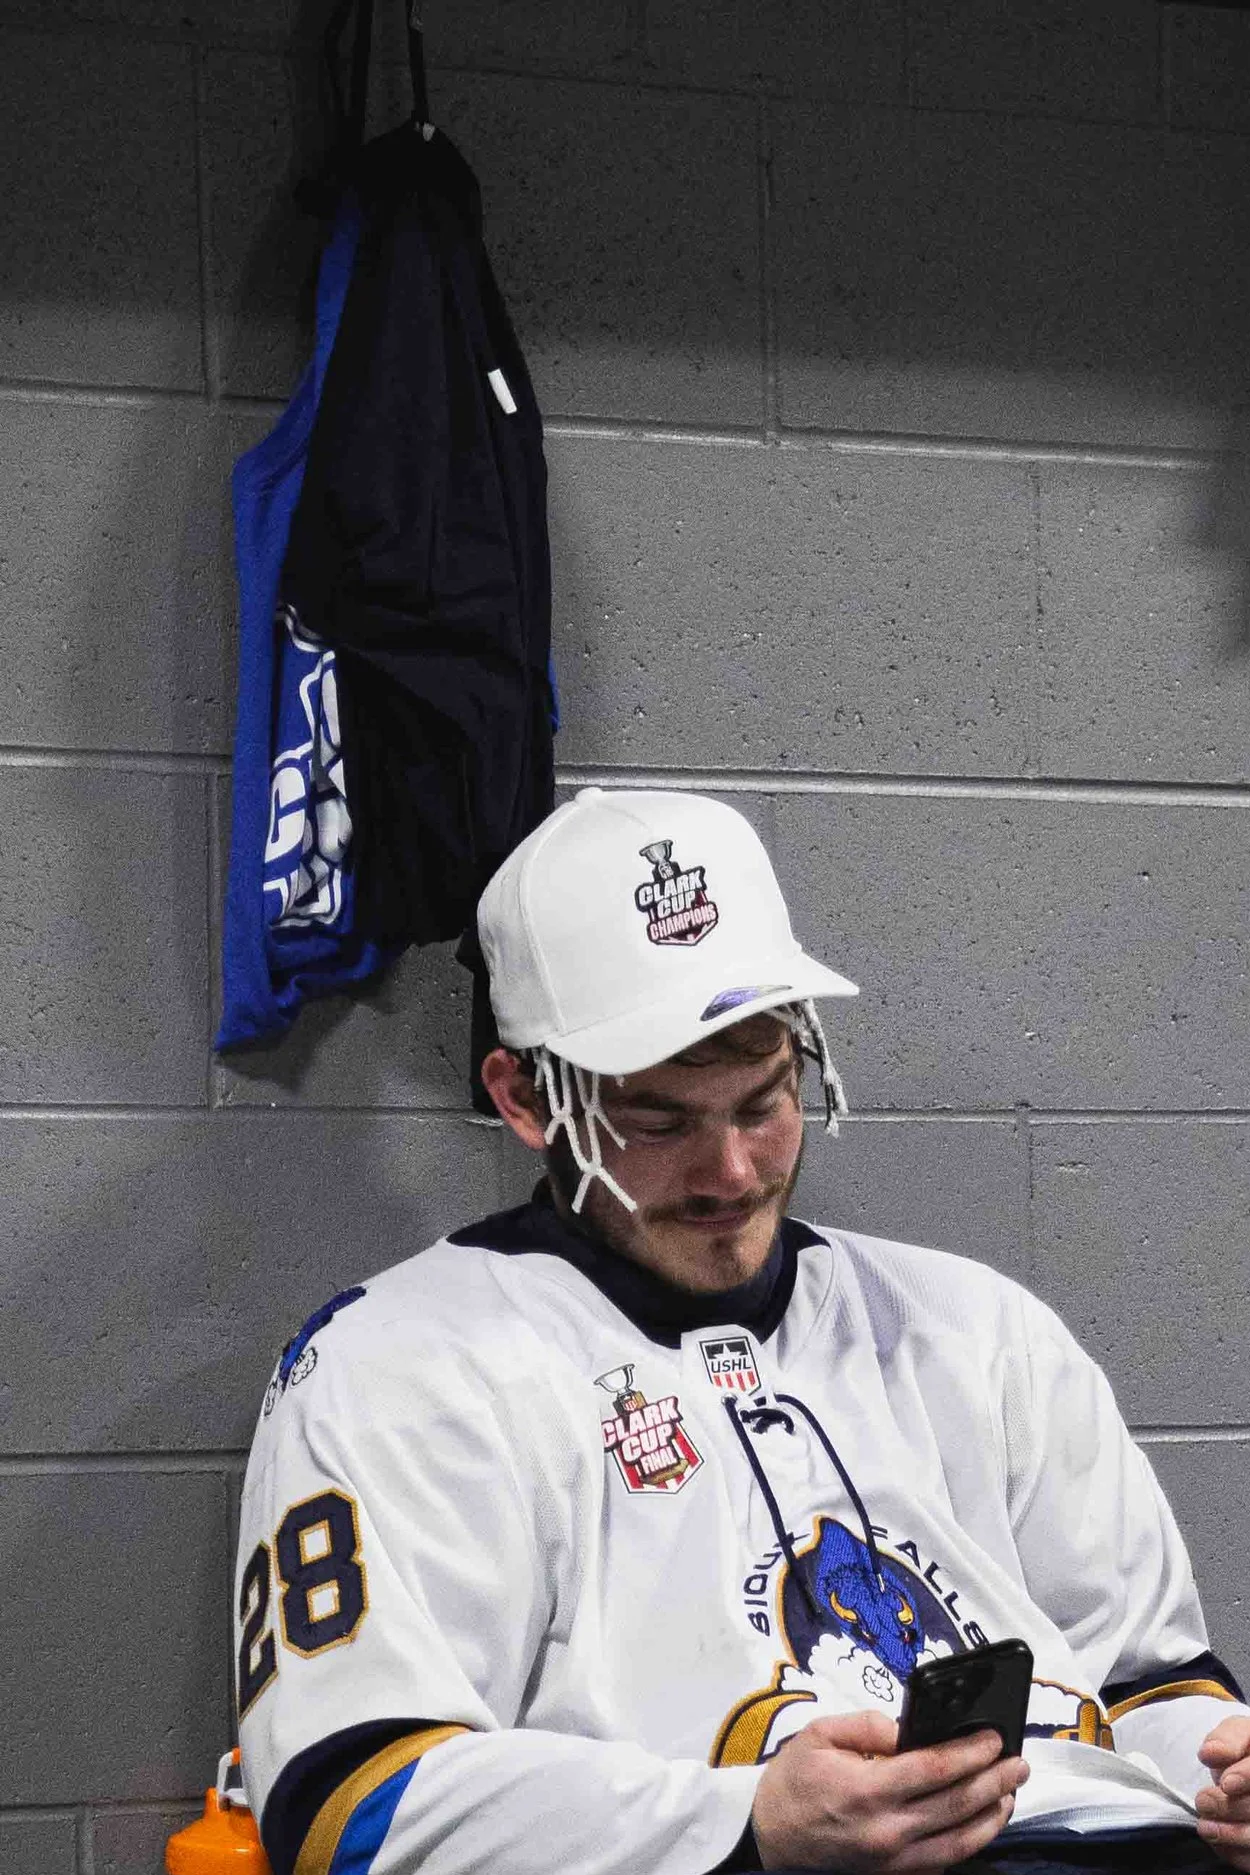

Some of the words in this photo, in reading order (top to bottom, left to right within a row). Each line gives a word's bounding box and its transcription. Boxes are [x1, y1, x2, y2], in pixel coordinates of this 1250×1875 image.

[638, 870, 703, 907] CLARK
[657, 890, 697, 919] CUP
[649, 903, 717, 941] CHAMPIONS
[711, 1358, 752, 1373] USHL
[601, 1398, 679, 1448] CLARK
[621, 1423, 673, 1462] CUP
[640, 1446, 678, 1475] FINAL
[237, 1487, 370, 1725] 28
